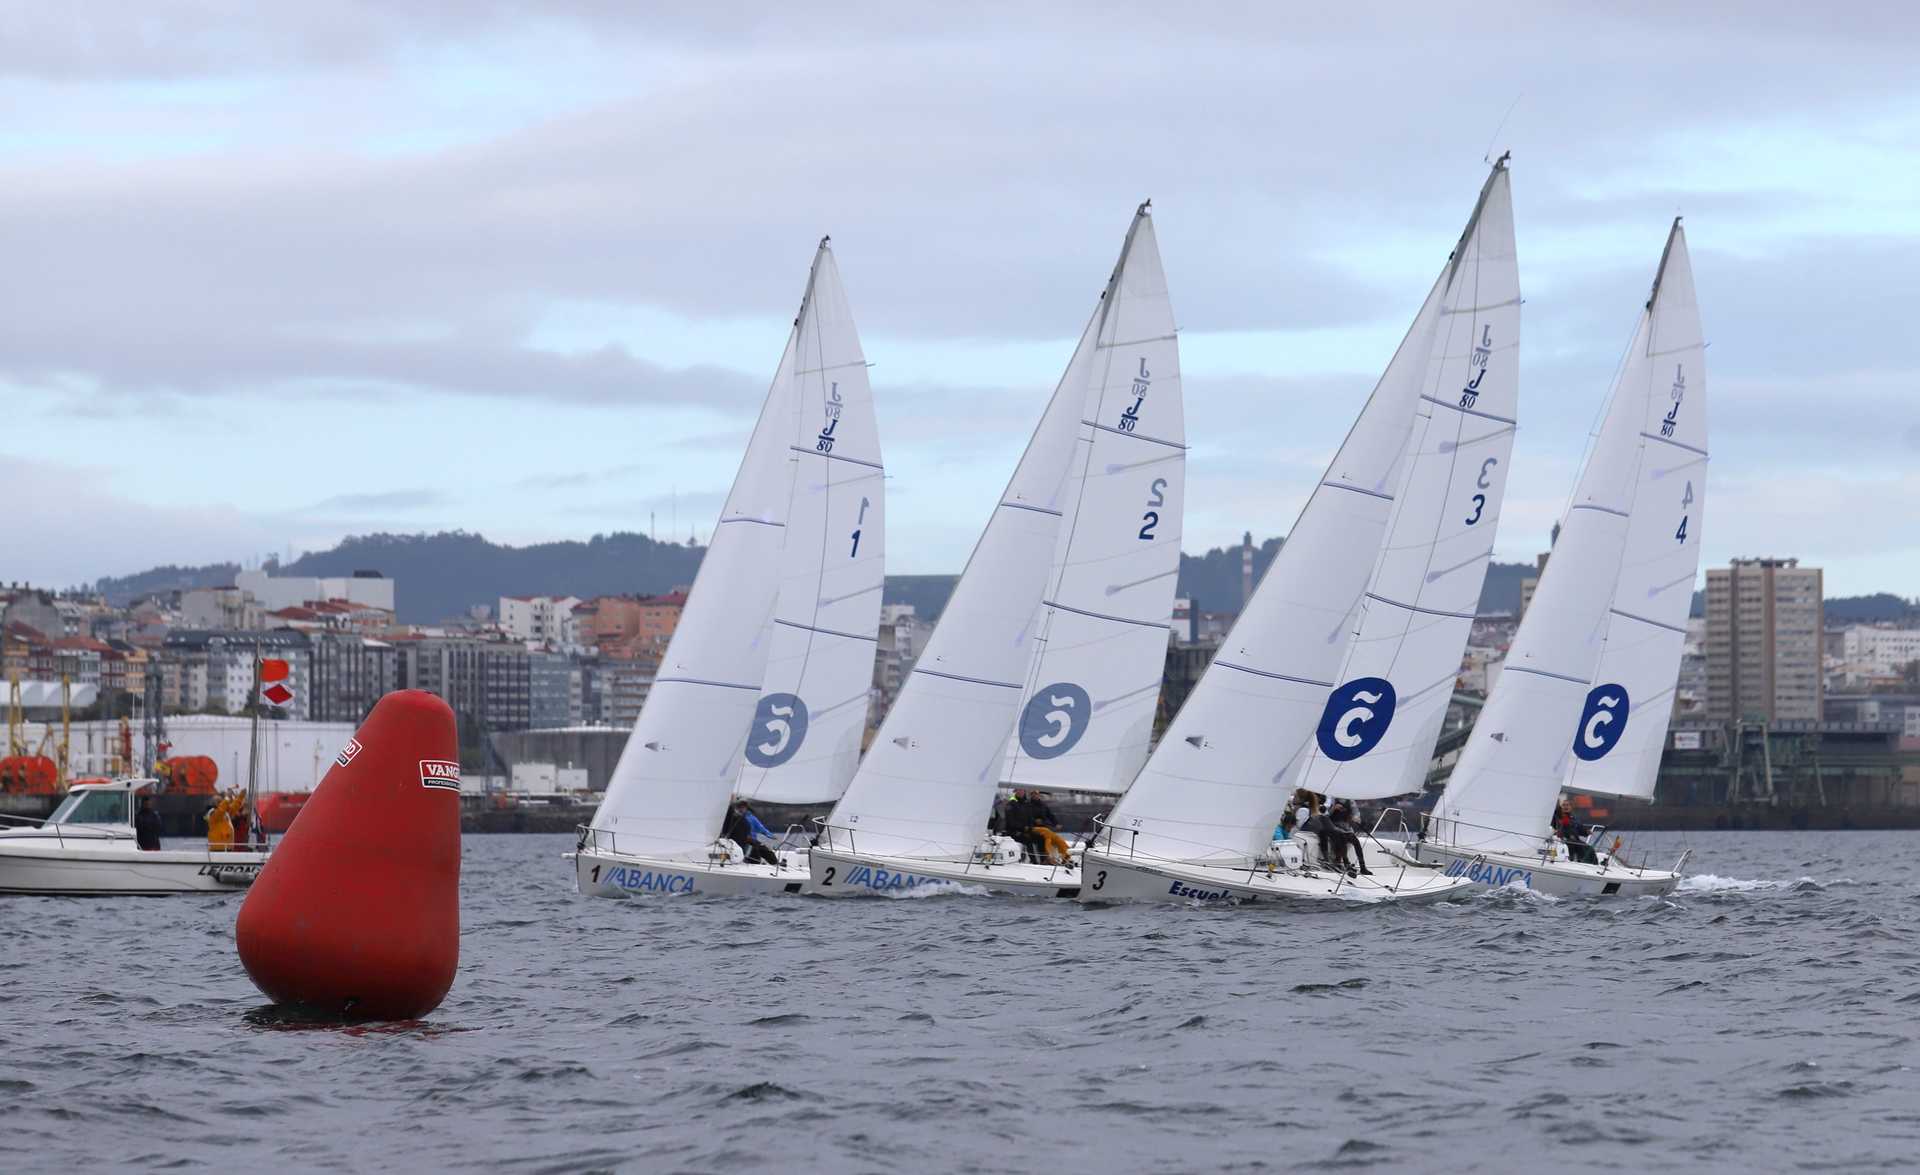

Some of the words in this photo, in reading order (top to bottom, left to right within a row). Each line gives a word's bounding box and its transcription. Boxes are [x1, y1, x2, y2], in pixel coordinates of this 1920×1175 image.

[1468, 368, 1487, 390] J
[1126, 397, 1143, 417] J
[1459, 394, 1477, 409] 80
[1666, 402, 1681, 421] J
[822, 419, 839, 436] J
[1118, 417, 1136, 432] 80
[1660, 424, 1675, 438] 80
[816, 440, 833, 453] 80
[1465, 494, 1486, 526] 3
[1138, 511, 1159, 540] 2
[1675, 515, 1688, 545] 4
[850, 529, 862, 558] 1
[591, 864, 601, 883] 1
[822, 866, 836, 886] 2
[1092, 870, 1107, 891] 3
